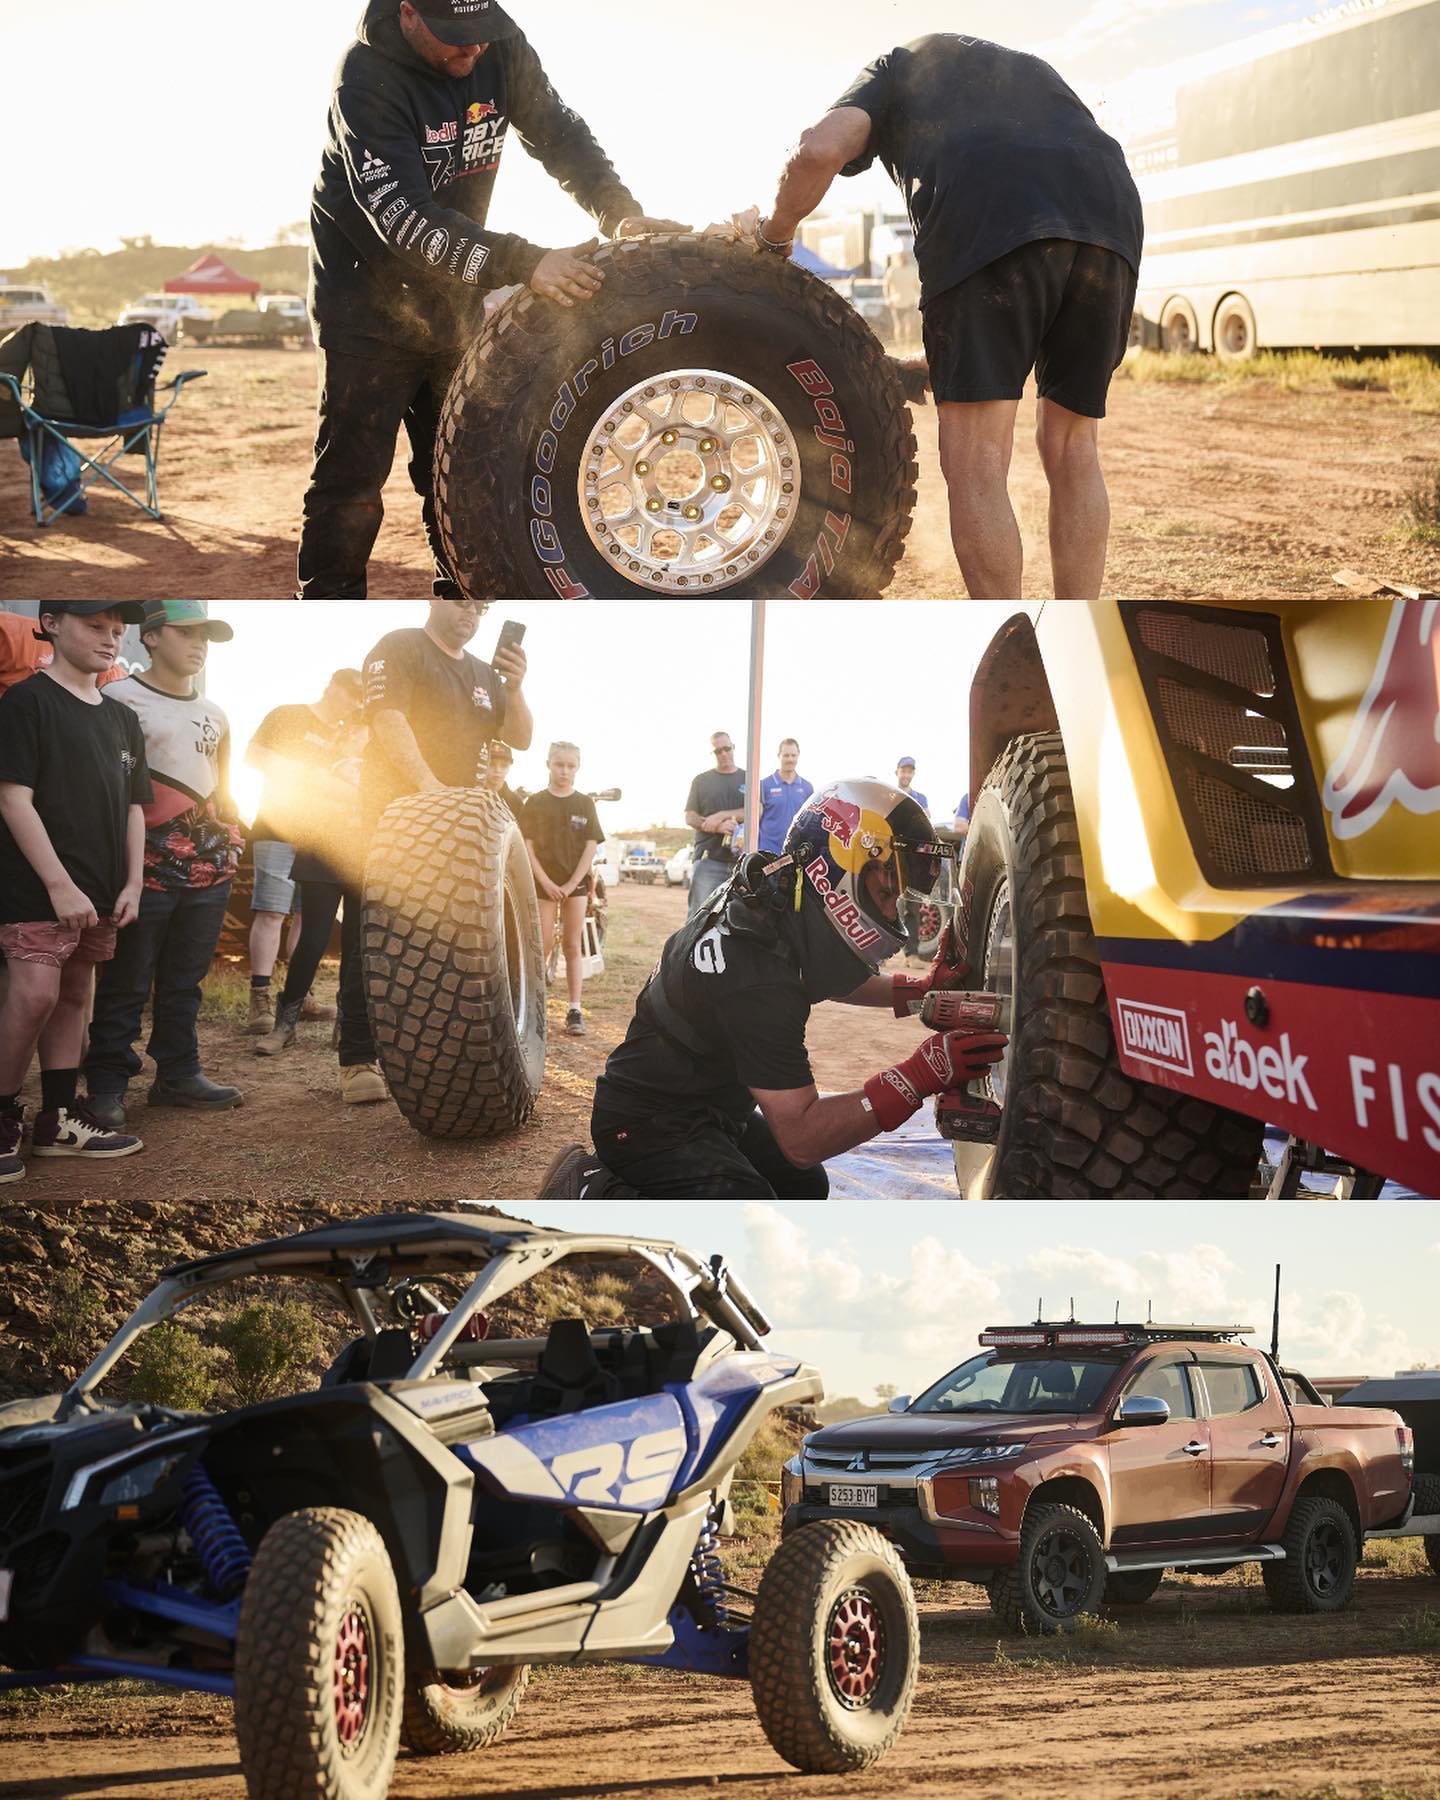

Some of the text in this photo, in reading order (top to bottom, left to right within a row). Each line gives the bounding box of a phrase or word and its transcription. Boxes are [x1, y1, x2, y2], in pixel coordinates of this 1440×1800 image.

[786, 359, 855, 494] Baja
[806, 855, 882, 950] Red Bull
[1122, 1009, 1185, 1061] DIXXON
[551, 1427, 687, 1506] RS
